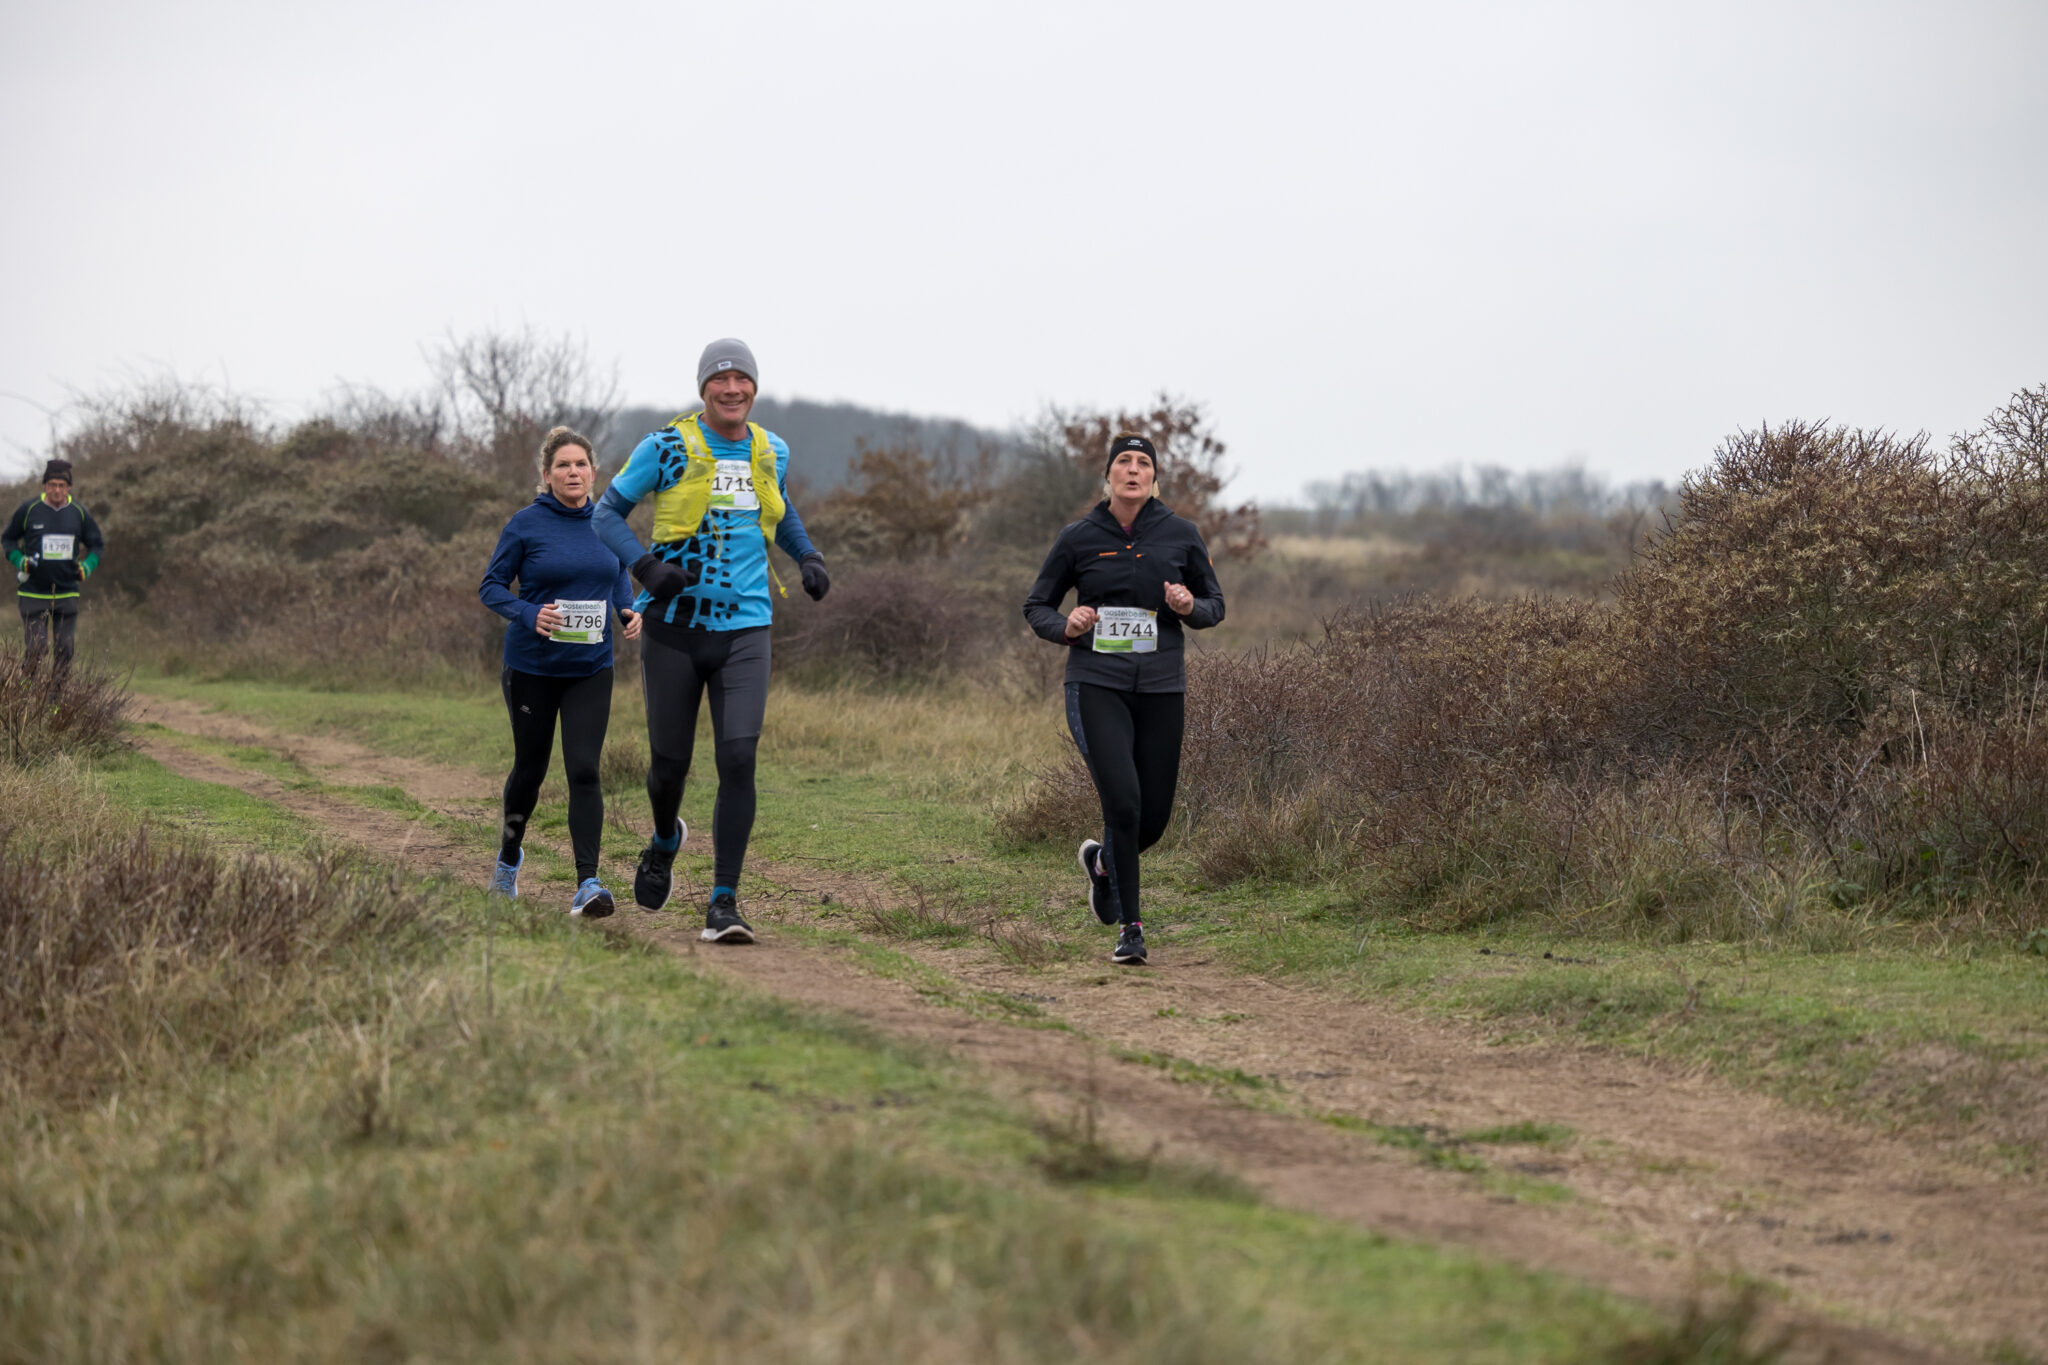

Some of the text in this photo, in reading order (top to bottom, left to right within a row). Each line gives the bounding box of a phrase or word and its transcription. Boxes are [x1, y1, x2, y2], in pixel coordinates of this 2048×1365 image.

[712, 476, 755, 492] 1719
[563, 615, 602, 629] 1796
[1109, 622, 1154, 637] 1744
